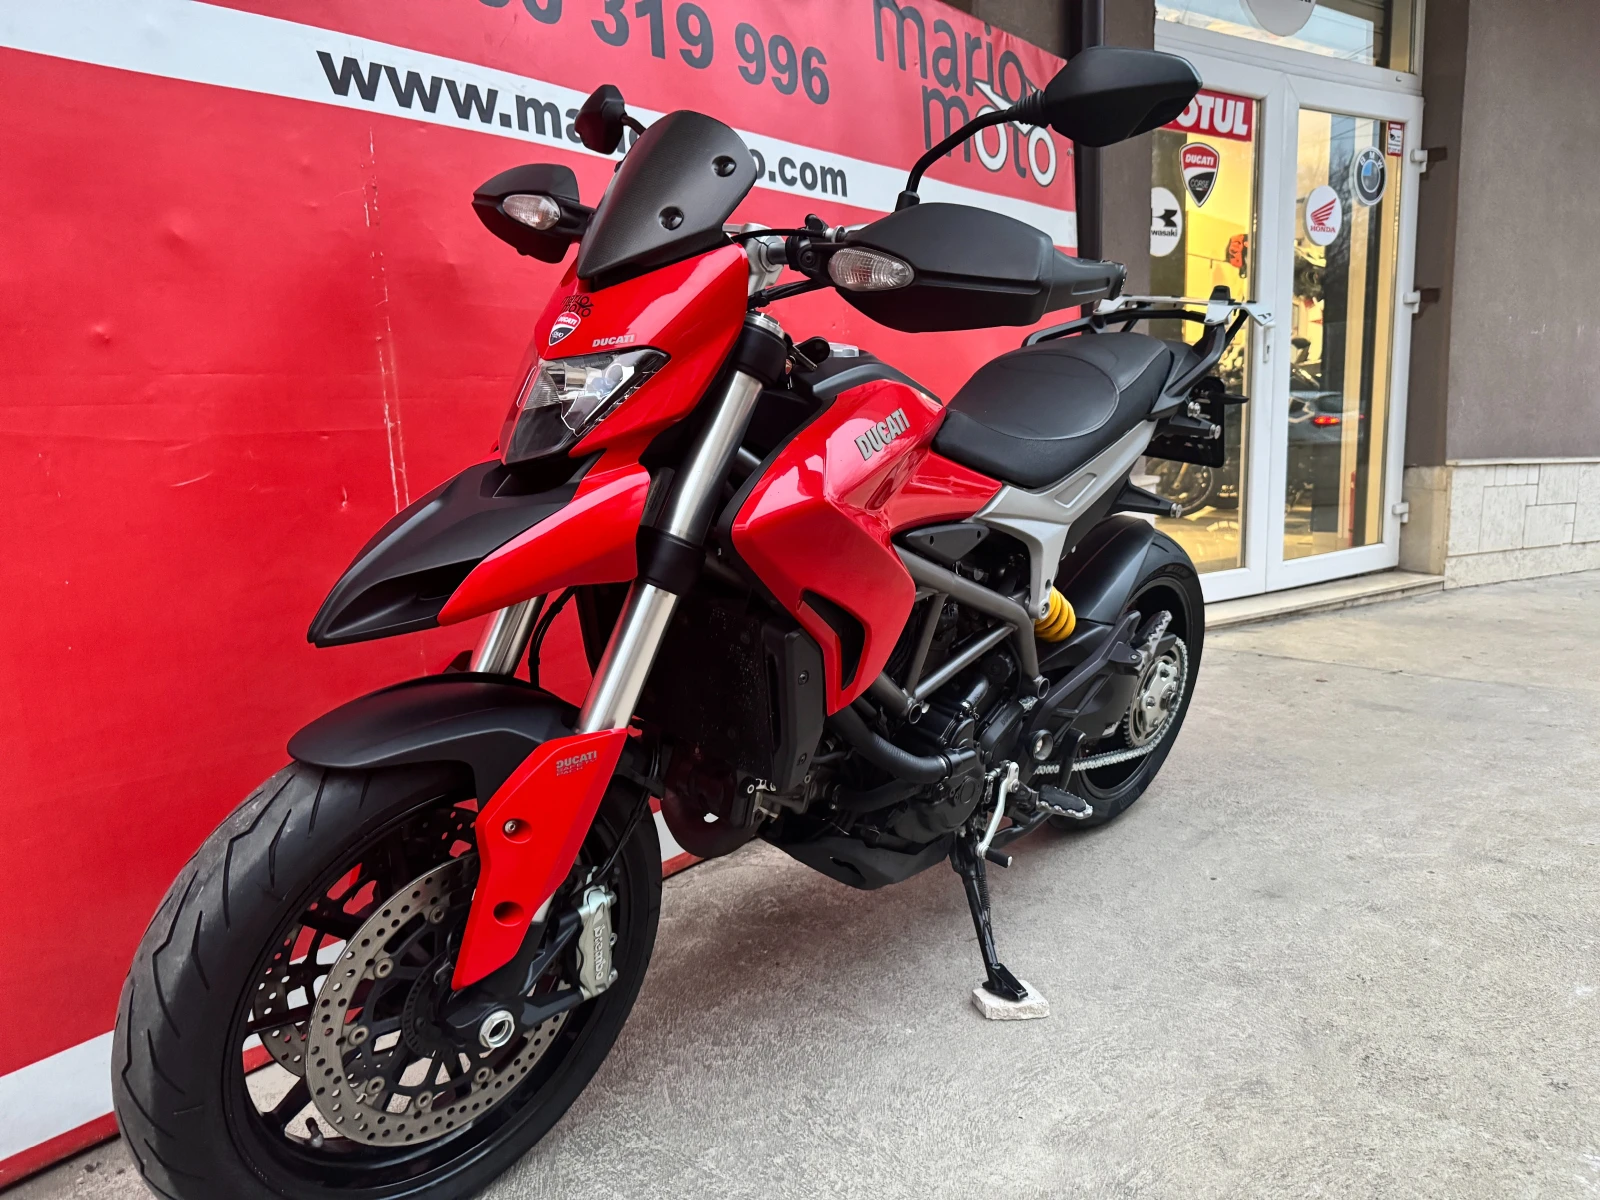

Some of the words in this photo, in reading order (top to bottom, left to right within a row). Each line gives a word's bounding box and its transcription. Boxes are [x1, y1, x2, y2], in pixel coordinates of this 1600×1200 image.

[590, 0, 713, 69] 319
[734, 22, 830, 105] 996
[873, 0, 1029, 105] mario
[1168, 94, 1248, 137] OTUL
[921, 85, 1057, 187] moto
[1185, 153, 1215, 166] DUCATI
[1359, 151, 1384, 170] BMW
[1190, 178, 1210, 189] CORSE
[1151, 228, 1178, 237] wasaki
[1310, 225, 1336, 234] HONDA
[592, 334, 635, 347] DUCATI
[854, 407, 911, 461] DUCATI
[556, 750, 598, 769] DUCATI
[594, 923, 606, 981] brembo
